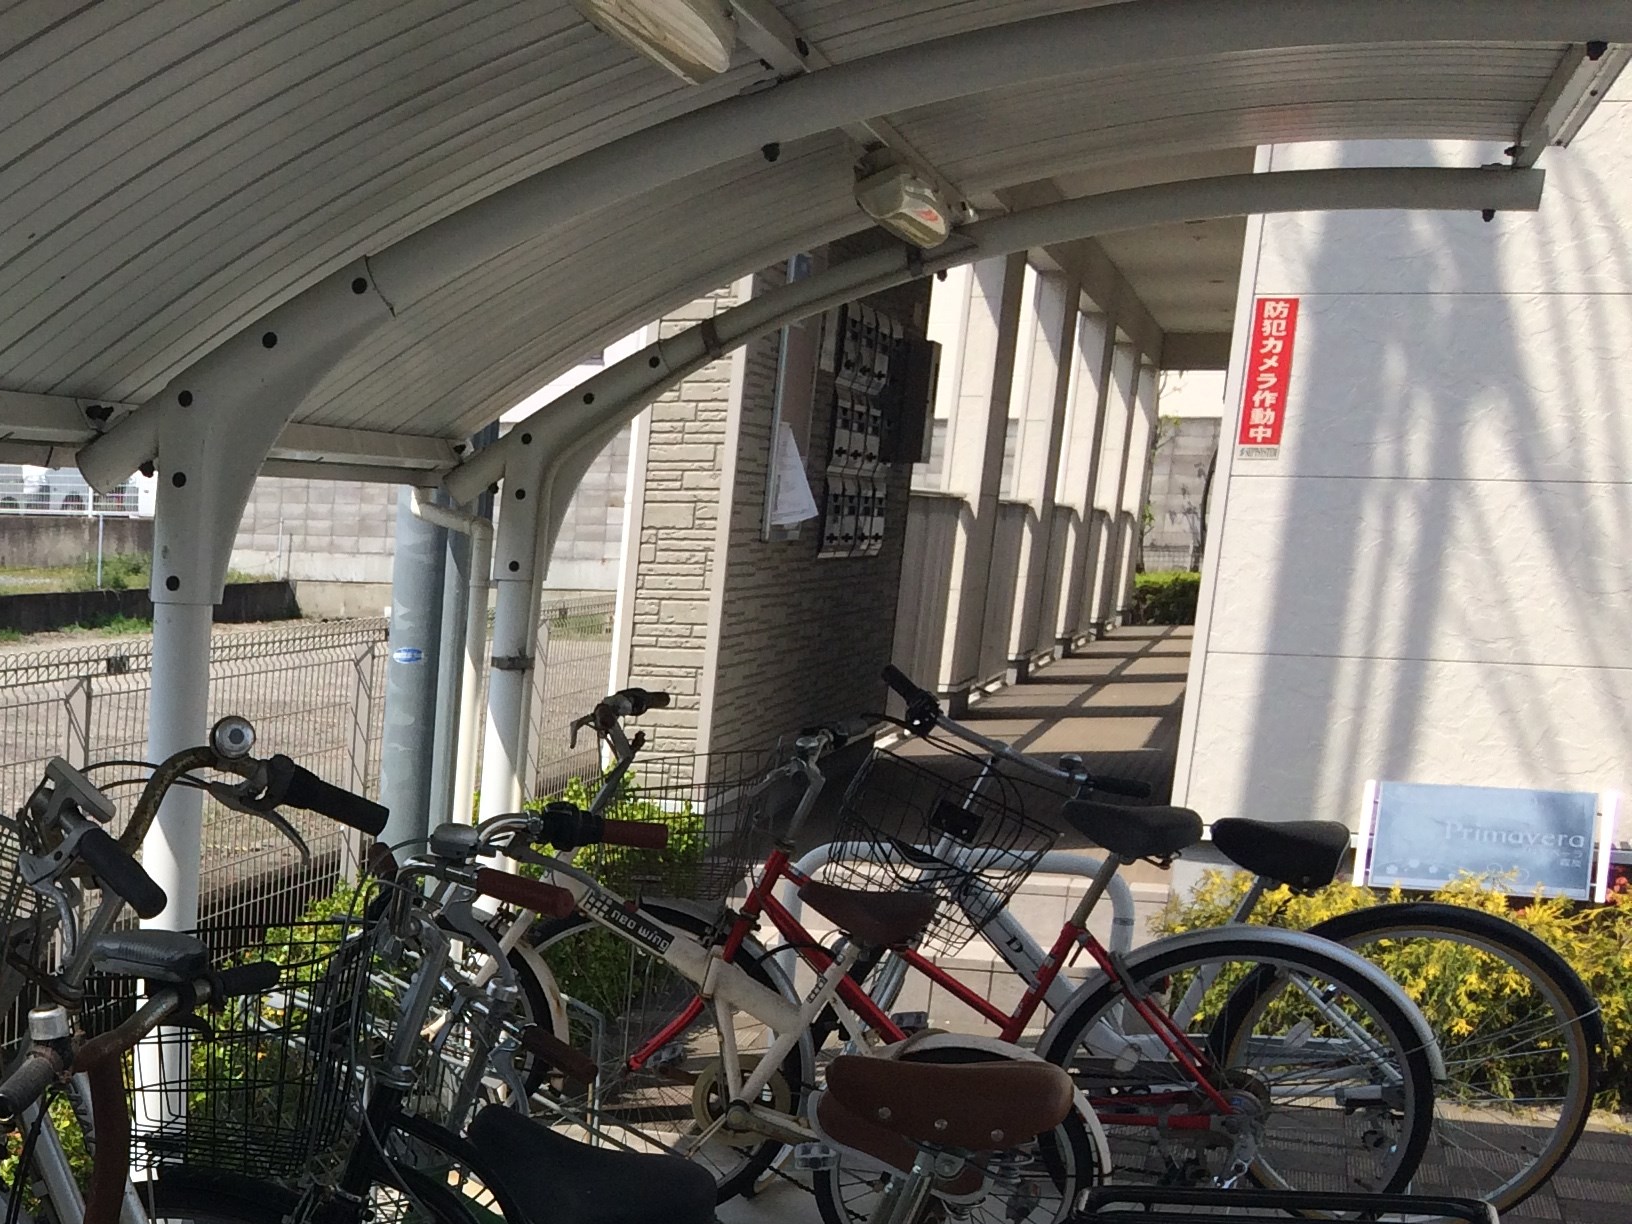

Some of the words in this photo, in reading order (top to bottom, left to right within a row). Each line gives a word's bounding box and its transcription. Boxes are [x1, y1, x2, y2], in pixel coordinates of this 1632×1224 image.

[1248, 301, 1290, 443] 防犯カメラ作動中
[1444, 821, 1585, 848] Primavera
[611, 910, 636, 930] neo
[637, 925, 670, 952] wing
